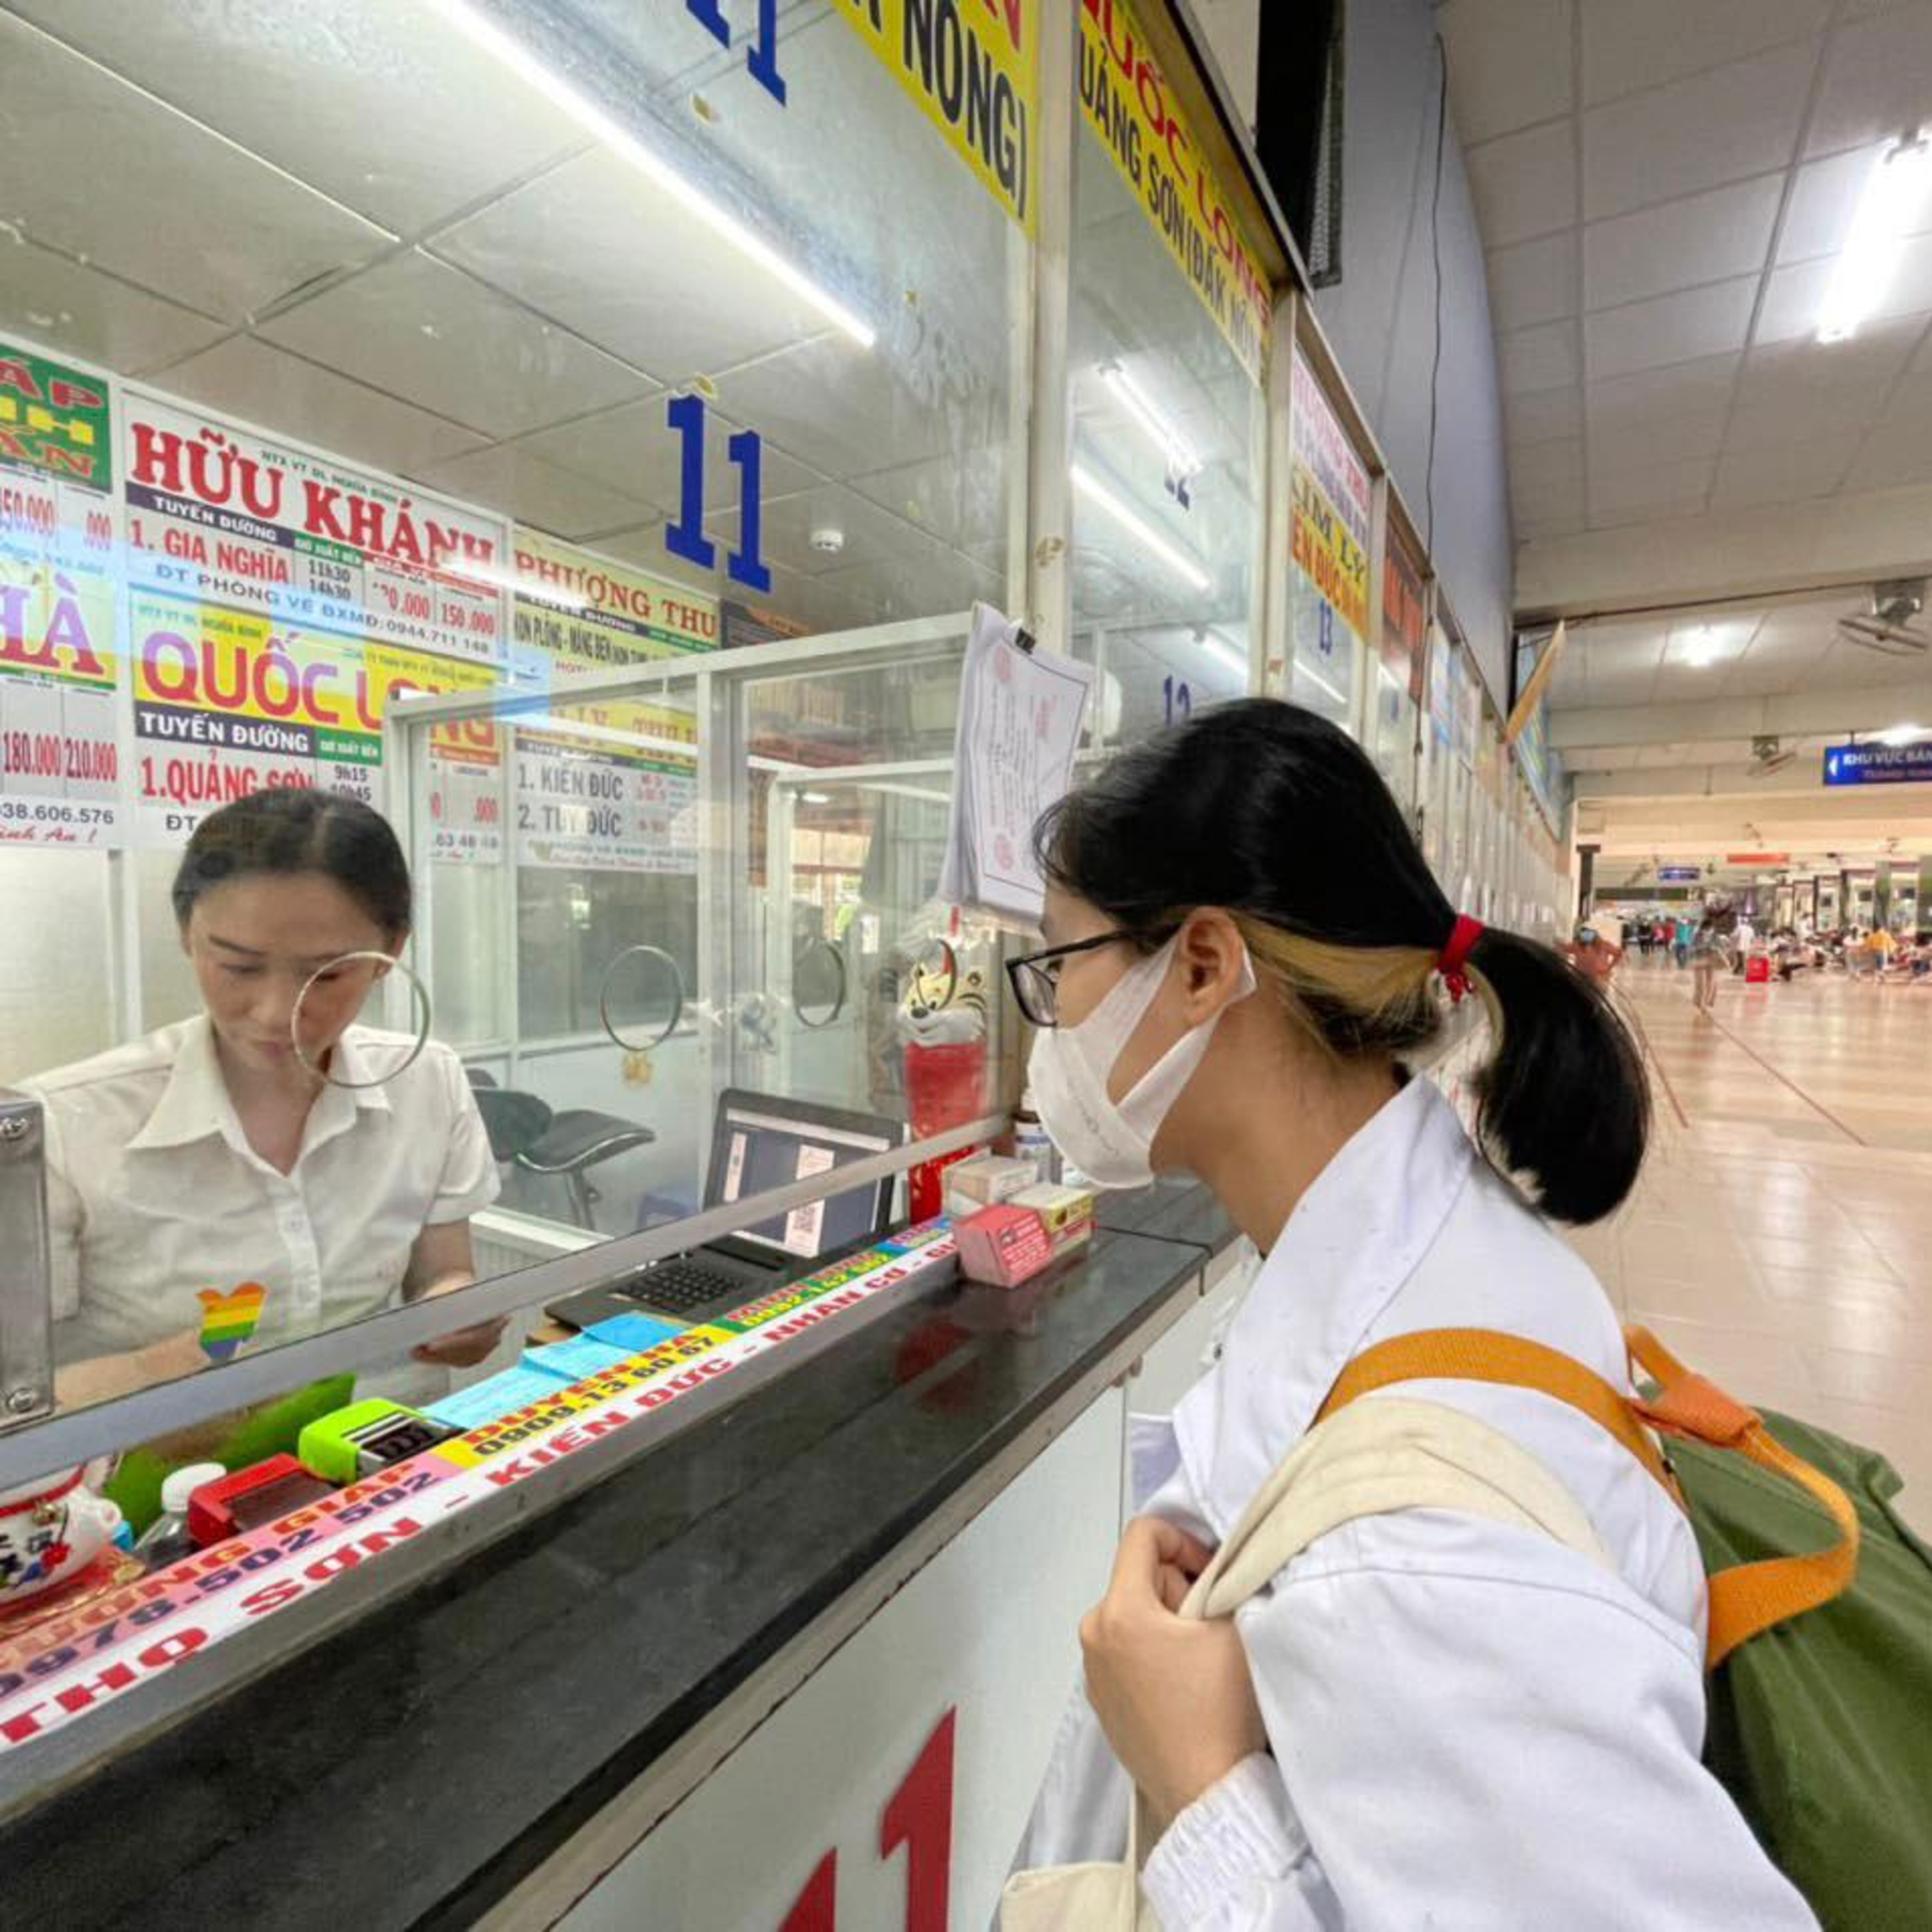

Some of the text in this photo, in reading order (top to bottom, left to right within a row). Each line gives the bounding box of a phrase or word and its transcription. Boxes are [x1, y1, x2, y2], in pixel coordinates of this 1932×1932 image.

[1080, 31, 1142, 189] UẢNG
[131, 421, 495, 569] HỮU KHÁNH
[665, 393, 771, 594] 11
[132, 518, 289, 583] 1. GIA NGHĨA
[308, 559, 352, 583] 11h30
[142, 632, 340, 725] QUỐC
[4, 732, 62, 777] 180.000
[140, 712, 225, 743] TUYẾN
[232, 724, 310, 753] ĐƯỜNG
[0, 800, 115, 826] 38.606.576
[334, 1472, 442, 1525] 502
